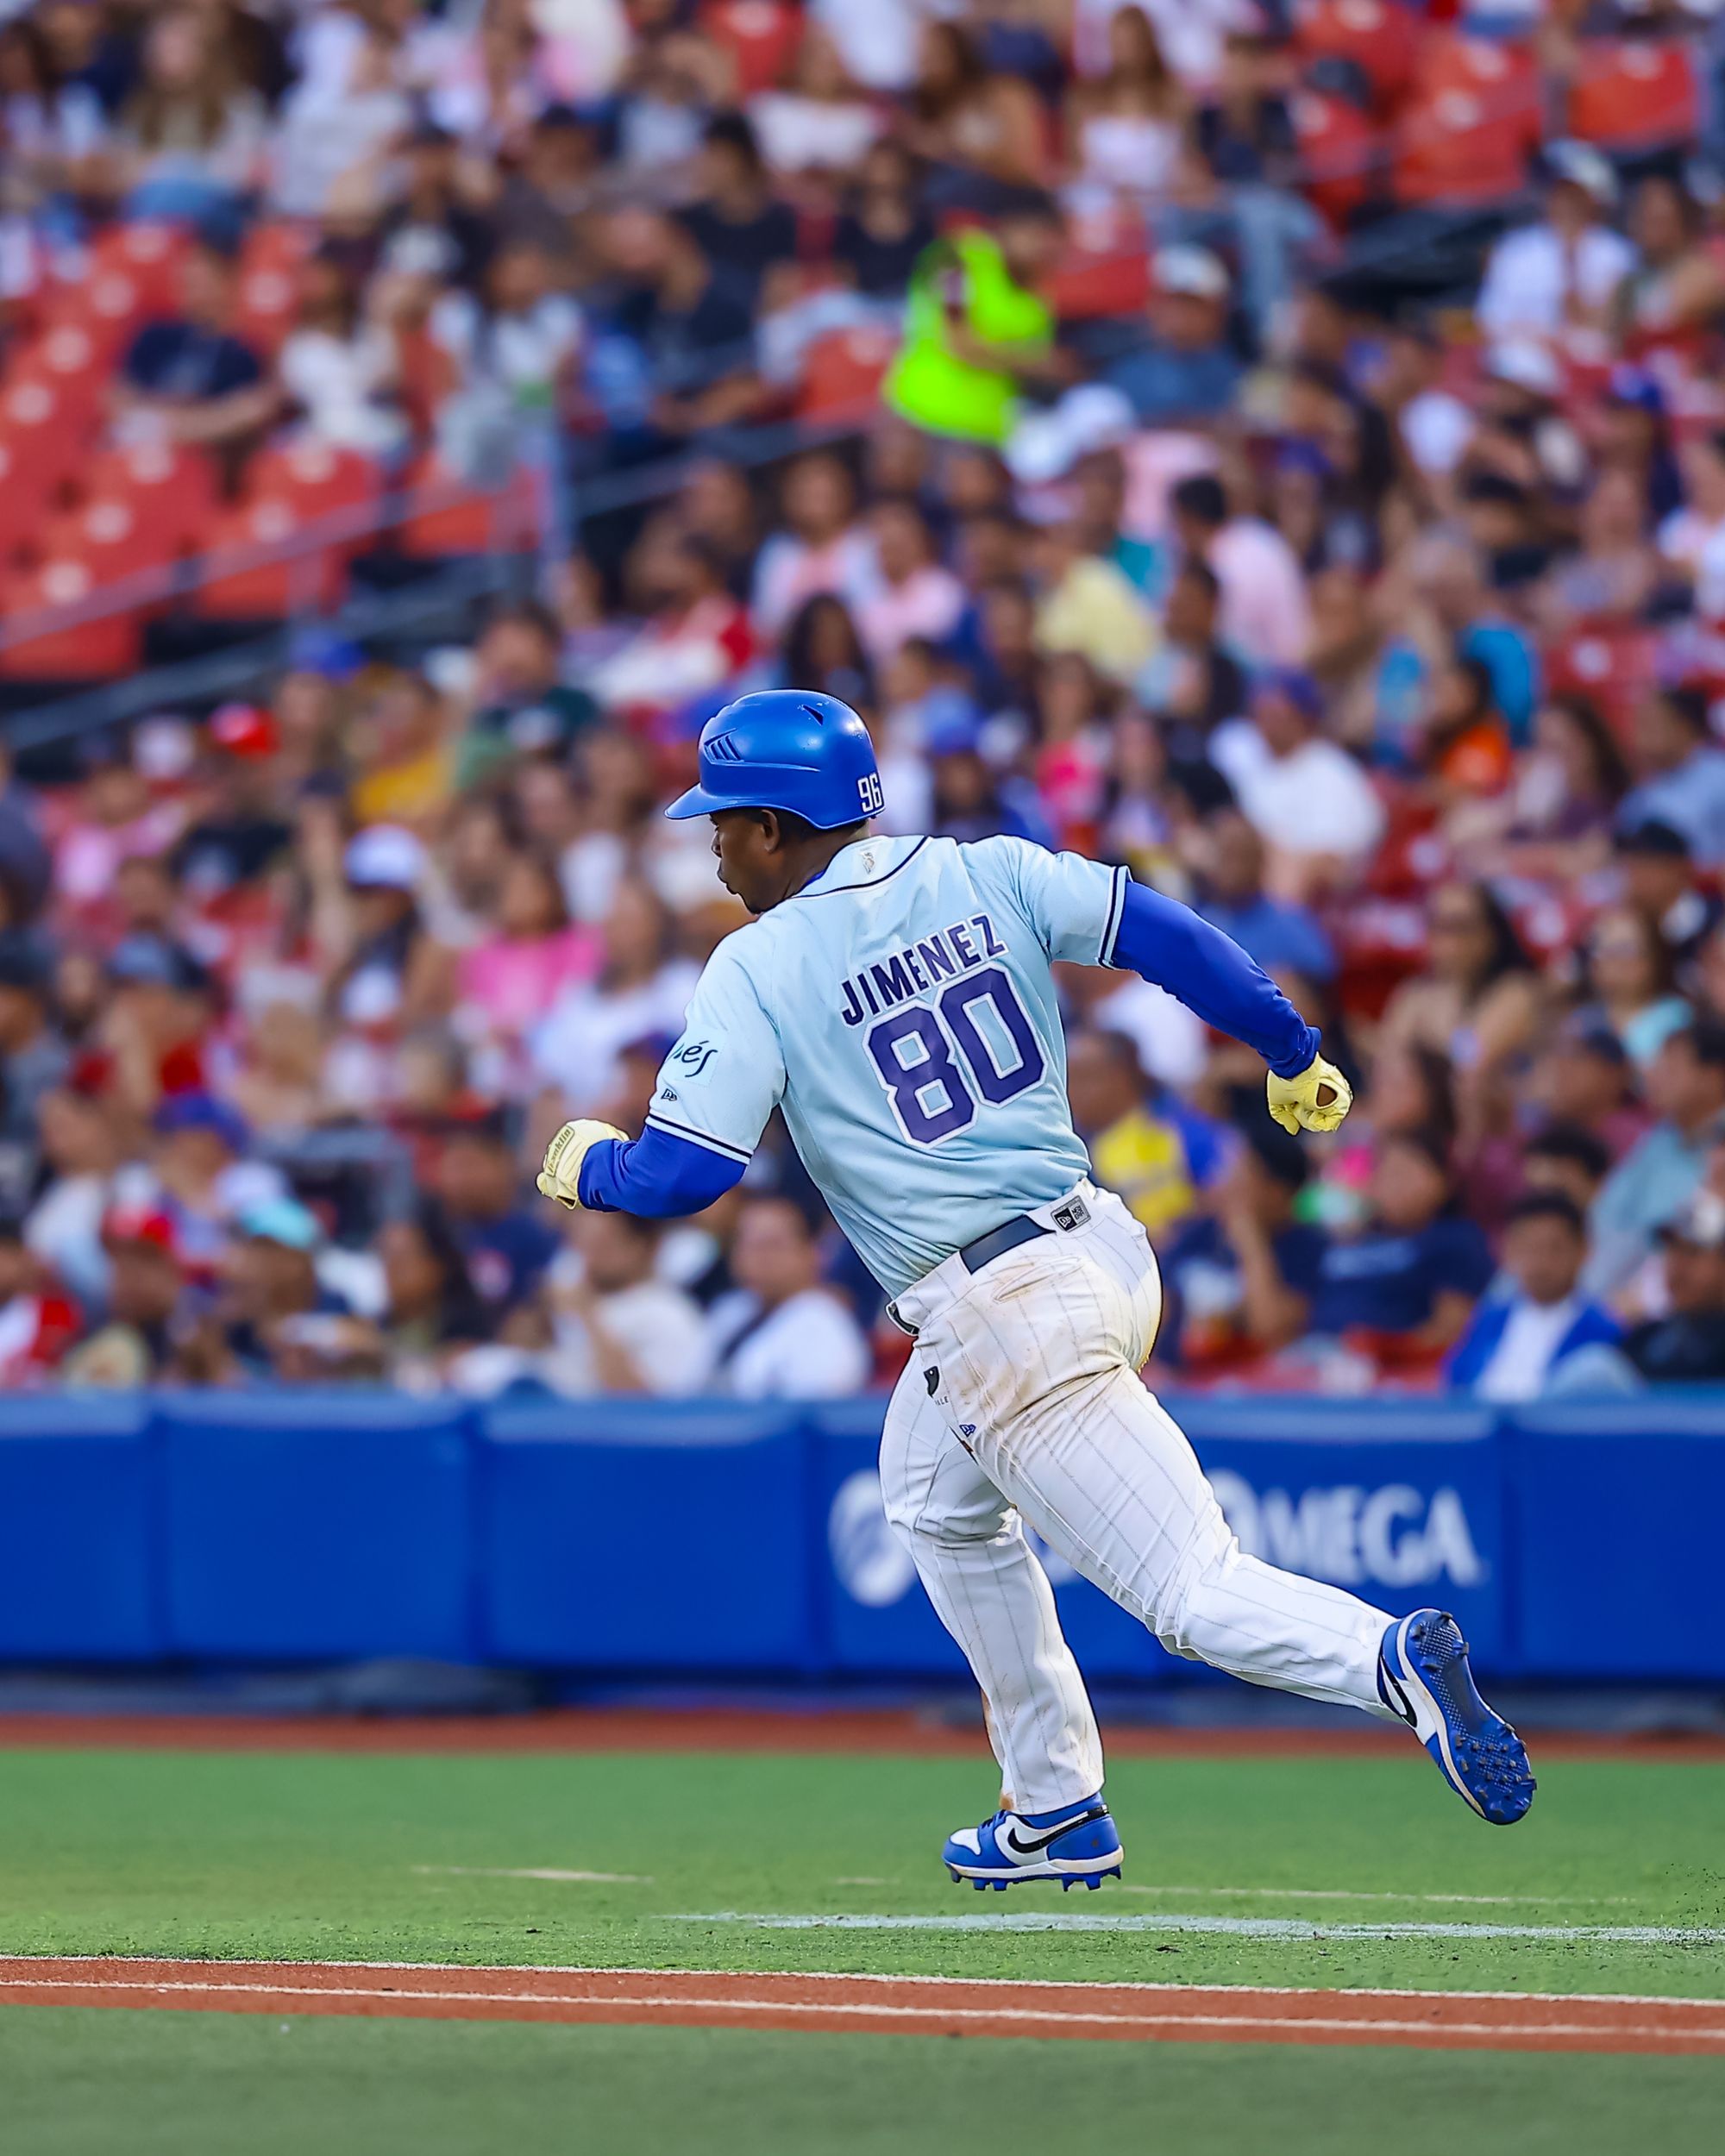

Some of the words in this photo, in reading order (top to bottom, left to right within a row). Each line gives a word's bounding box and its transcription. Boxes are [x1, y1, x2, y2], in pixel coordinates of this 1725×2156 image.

[857, 773, 882, 812] 96
[841, 913, 1008, 1027] JIMENEZ
[863, 962, 1047, 1149] 80
